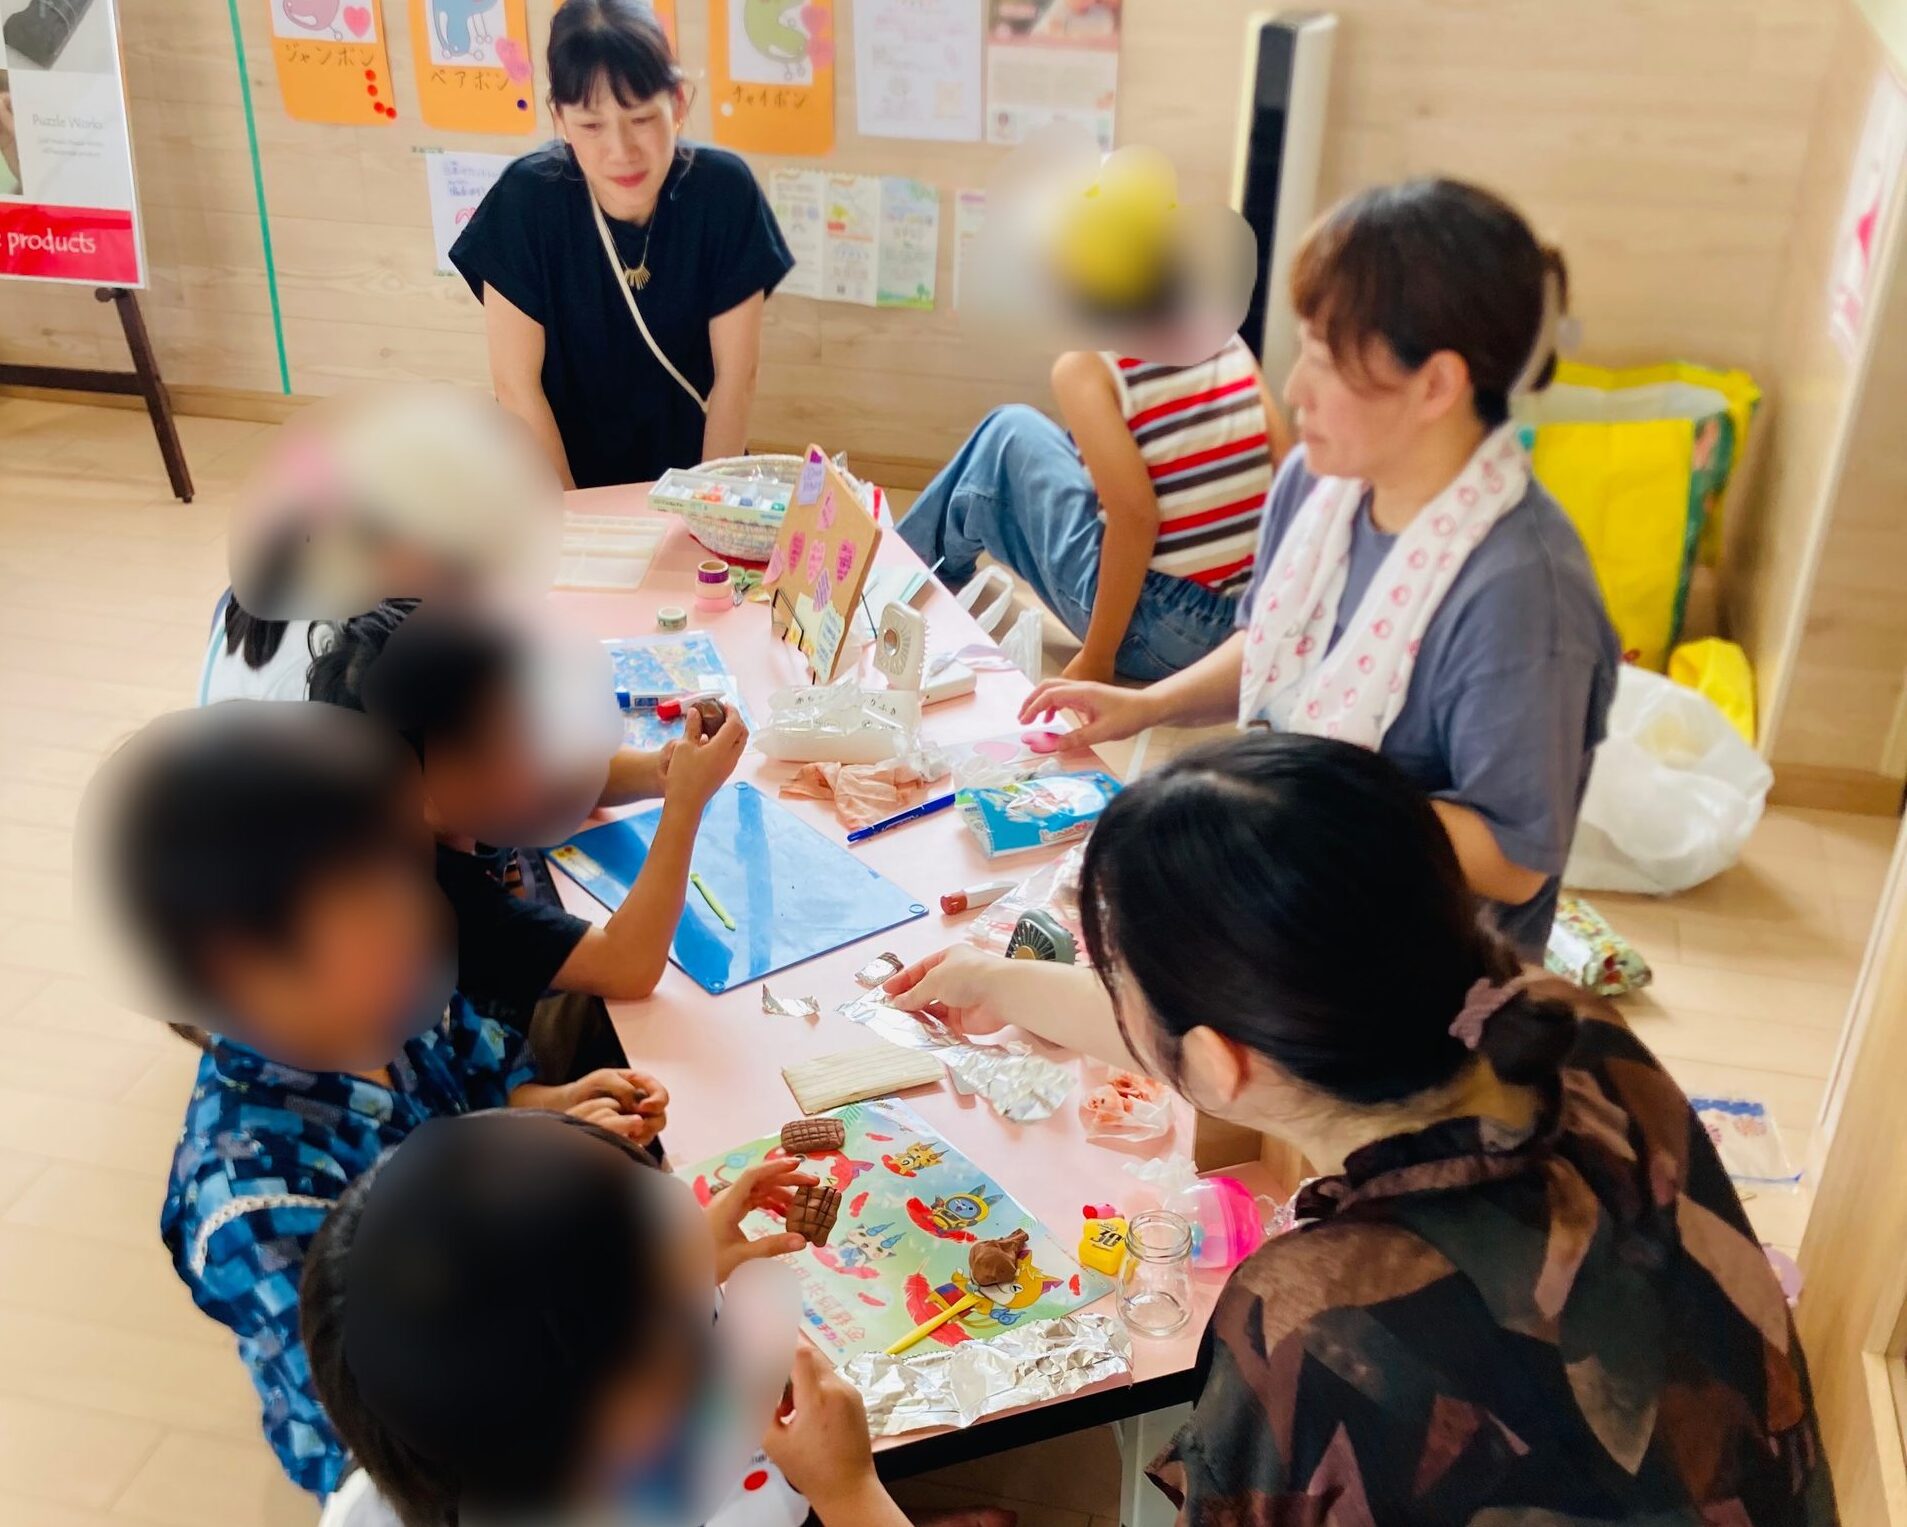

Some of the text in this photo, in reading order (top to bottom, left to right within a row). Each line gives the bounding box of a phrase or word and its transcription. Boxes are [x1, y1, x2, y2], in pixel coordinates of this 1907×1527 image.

[32, 113, 104, 130] Puzzle Works
[7, 227, 97, 256] products
